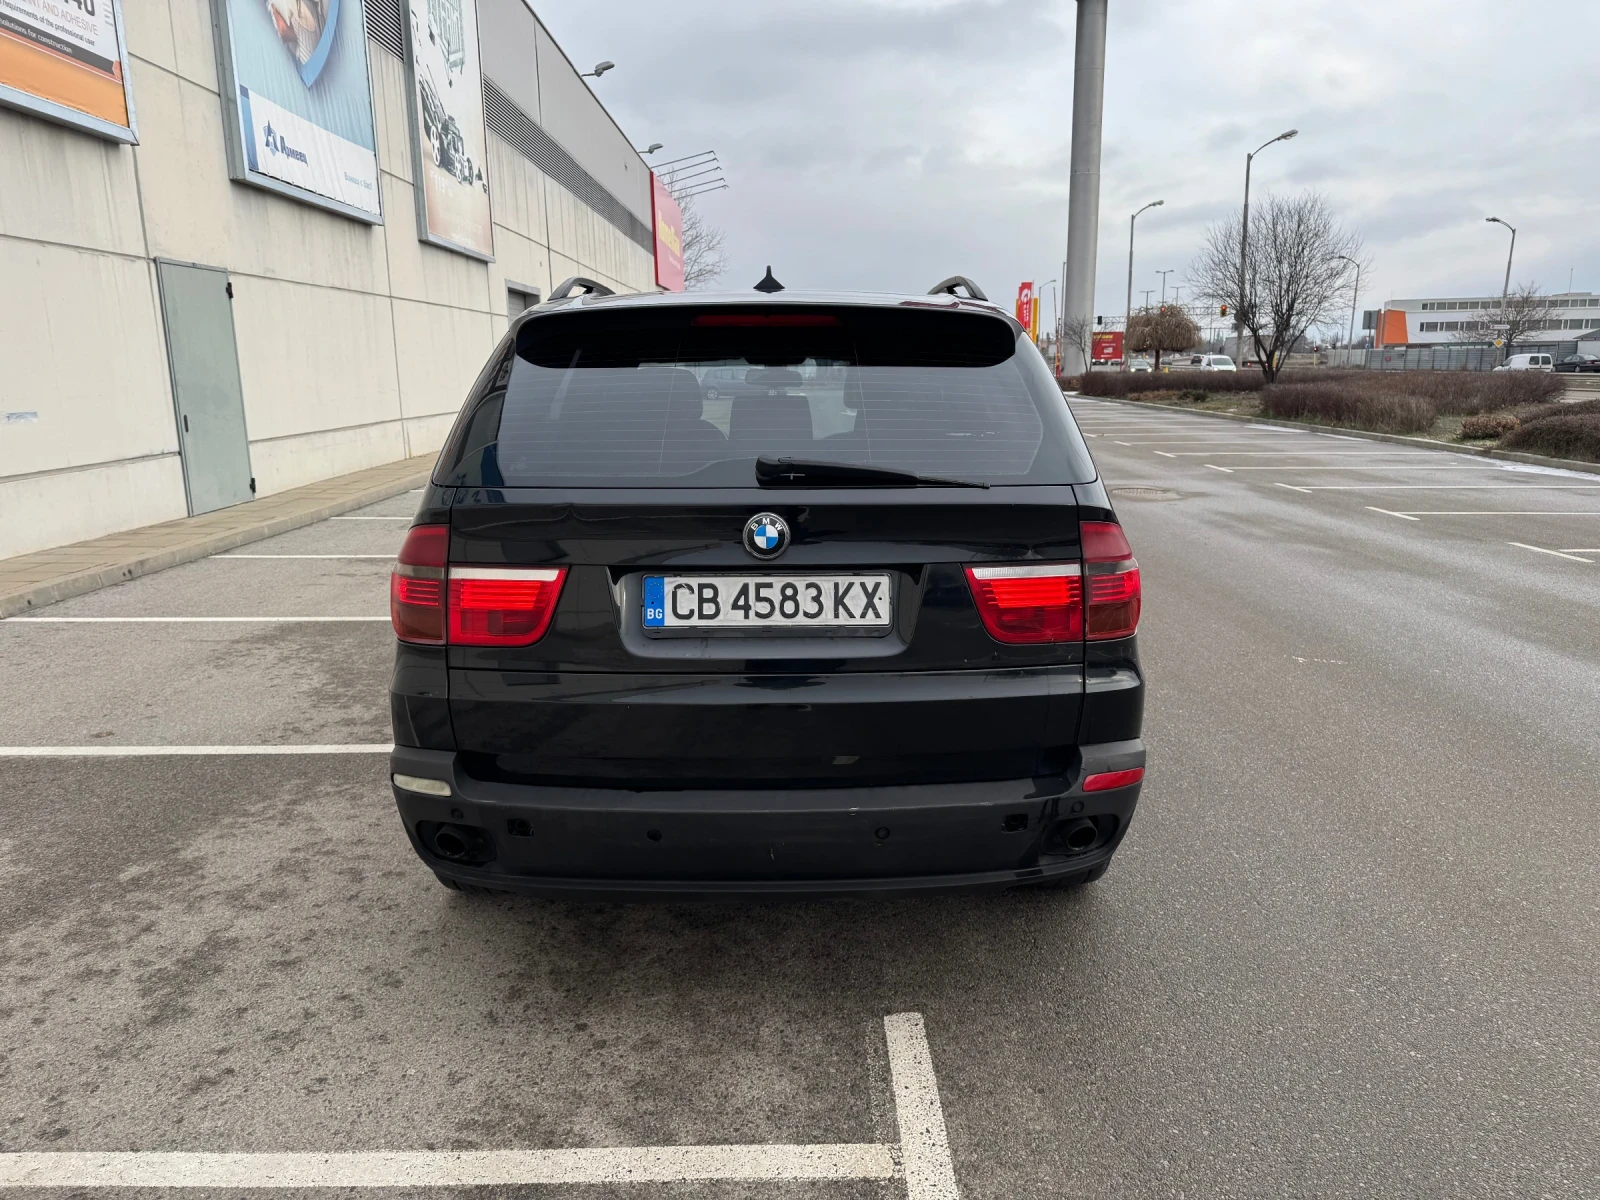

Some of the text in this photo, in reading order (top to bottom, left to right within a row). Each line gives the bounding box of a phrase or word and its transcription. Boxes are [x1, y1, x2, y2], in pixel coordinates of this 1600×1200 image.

[39, 16, 45, 24] of
[45, 18, 54, 28] the
[54, 23, 84, 42] professional
[42, 1, 59, 17] AND
[60, 10, 98, 36] ADHESIVE
[27, 29, 37, 39] for
[37, 35, 73, 54] construction
[279, 135, 309, 167] Армеец
[750, 517, 783, 532] BMW
[647, 608, 663, 619] BG
[671, 581, 882, 620] CB 4583 KX
